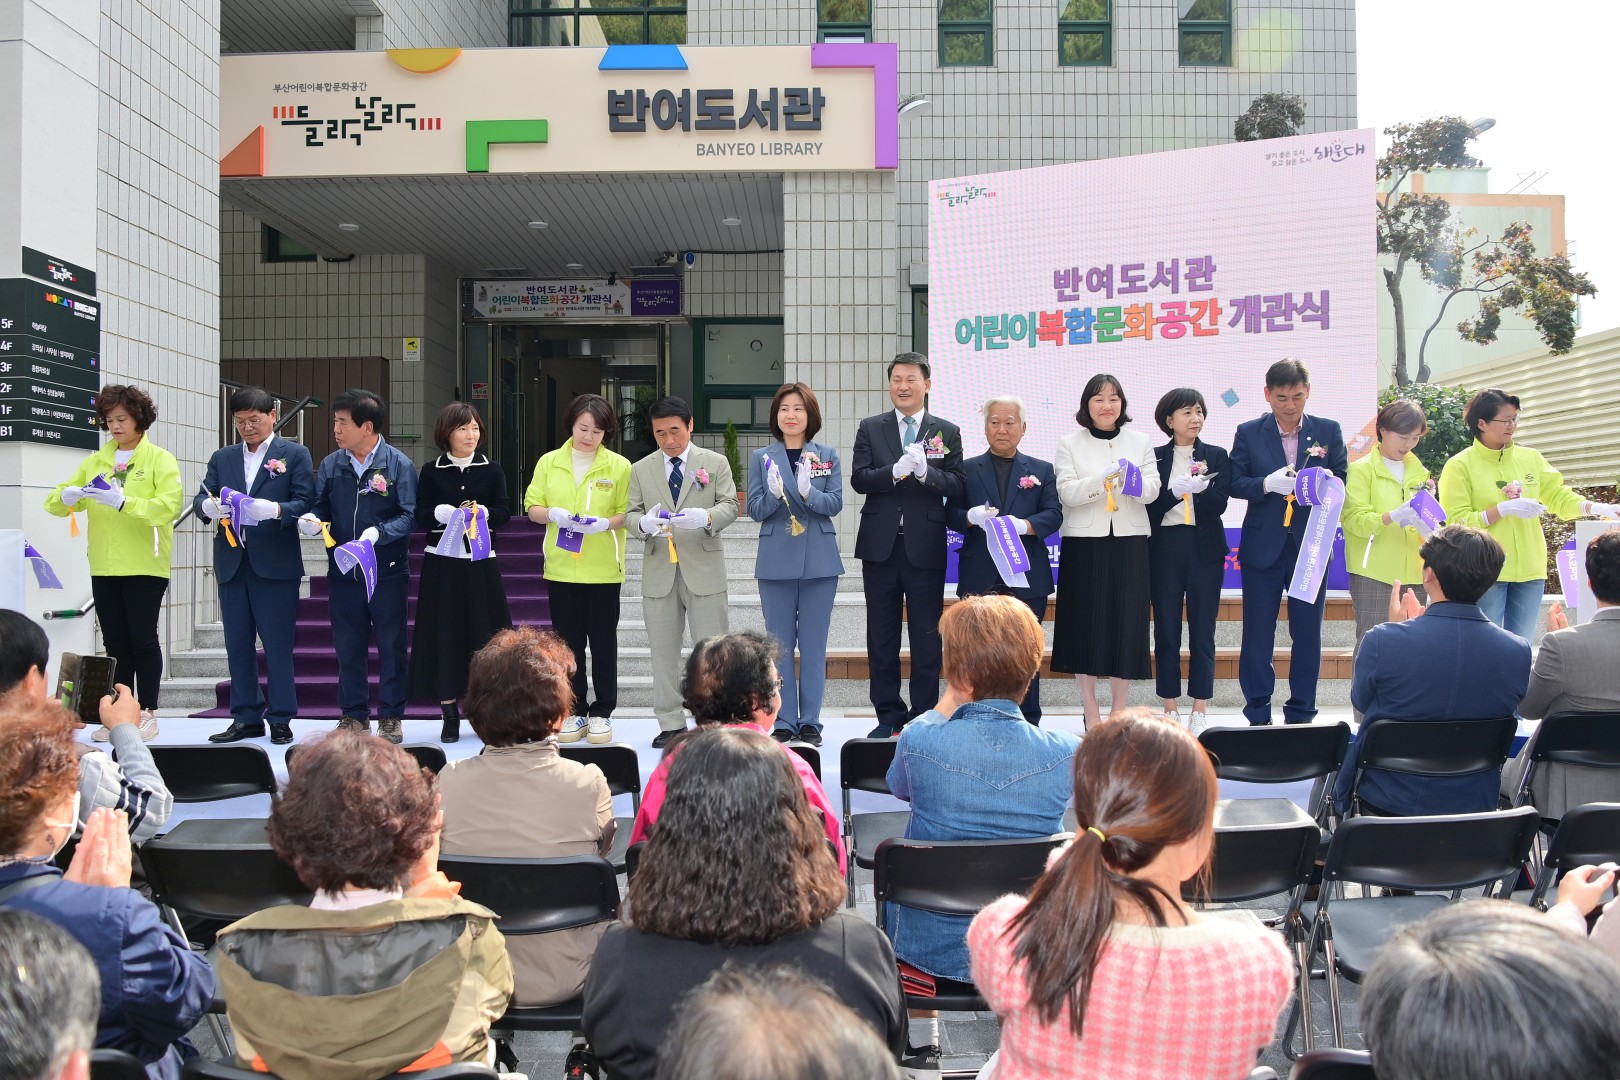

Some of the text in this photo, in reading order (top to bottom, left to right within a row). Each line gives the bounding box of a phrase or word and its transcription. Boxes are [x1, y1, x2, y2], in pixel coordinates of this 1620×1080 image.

[273, 81, 367, 93] 부산어린이복합문화공간
[608, 87, 826, 132] 반여도서관
[696, 142, 823, 156] BANYEO LIBRARY
[1314, 143, 1365, 162] 해운대
[1053, 255, 1217, 302] 반여도서관
[526, 285, 578, 295] 반여도서관
[492, 294, 612, 305] 어린이복합문화공간 개관식
[1, 318, 14, 329] 5F
[955, 290, 1330, 352] 어린이복합문화공간 개관식
[0, 340, 13, 351] 4F
[0, 362, 13, 372] 3F
[0, 382, 13, 393] 2F
[1, 404, 13, 415] 1F
[0, 426, 13, 436] B1
